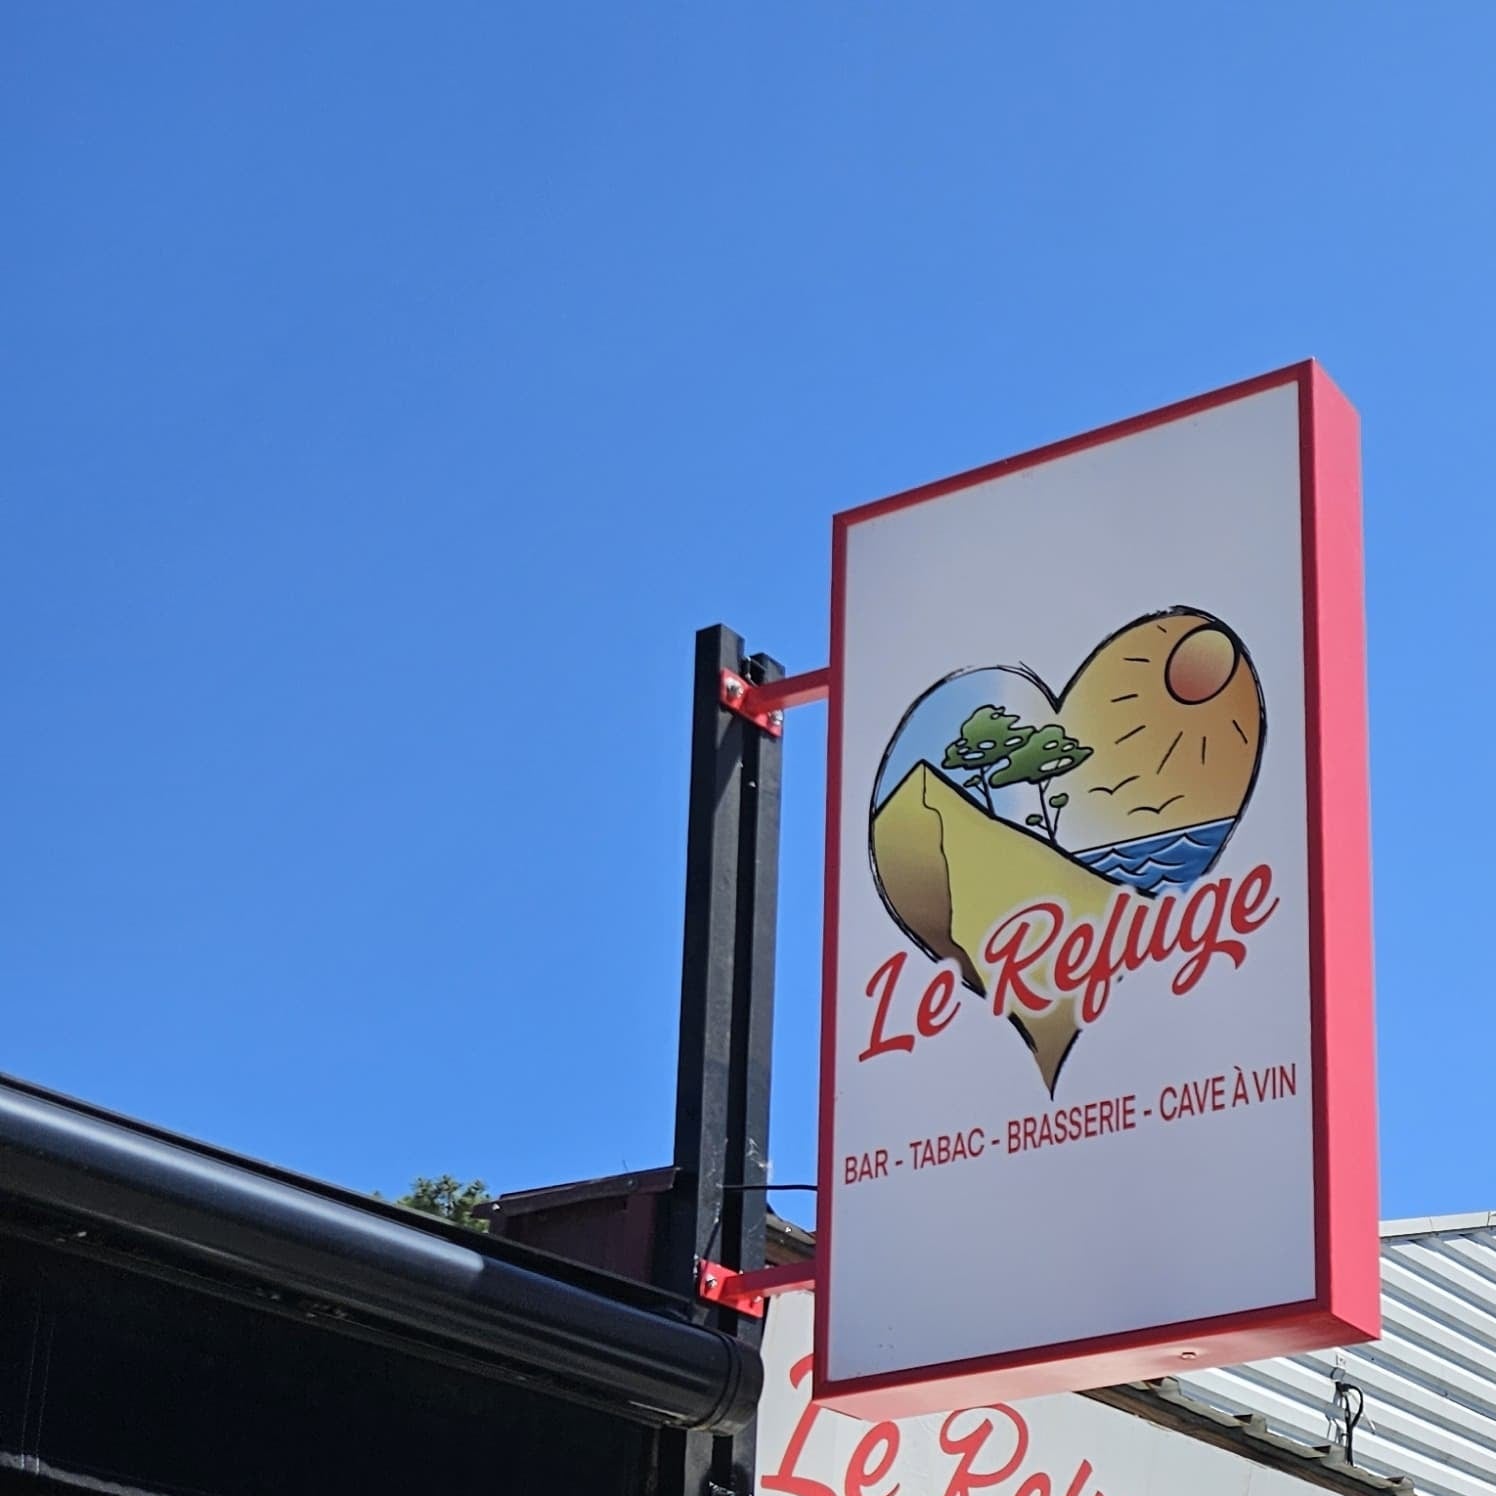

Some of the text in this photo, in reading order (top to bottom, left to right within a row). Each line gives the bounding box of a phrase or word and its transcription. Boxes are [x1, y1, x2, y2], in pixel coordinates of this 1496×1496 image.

[858, 864, 1280, 1063] Le Refuge
[844, 1149, 889, 1185] BAR
[909, 1127, 986, 1172] TABAC
[1007, 1094, 1137, 1155] BRASSERIE
[1158, 1074, 1226, 1122] CAVE
[1231, 1066, 1250, 1108] À
[1256, 1062, 1297, 1101] VIN
